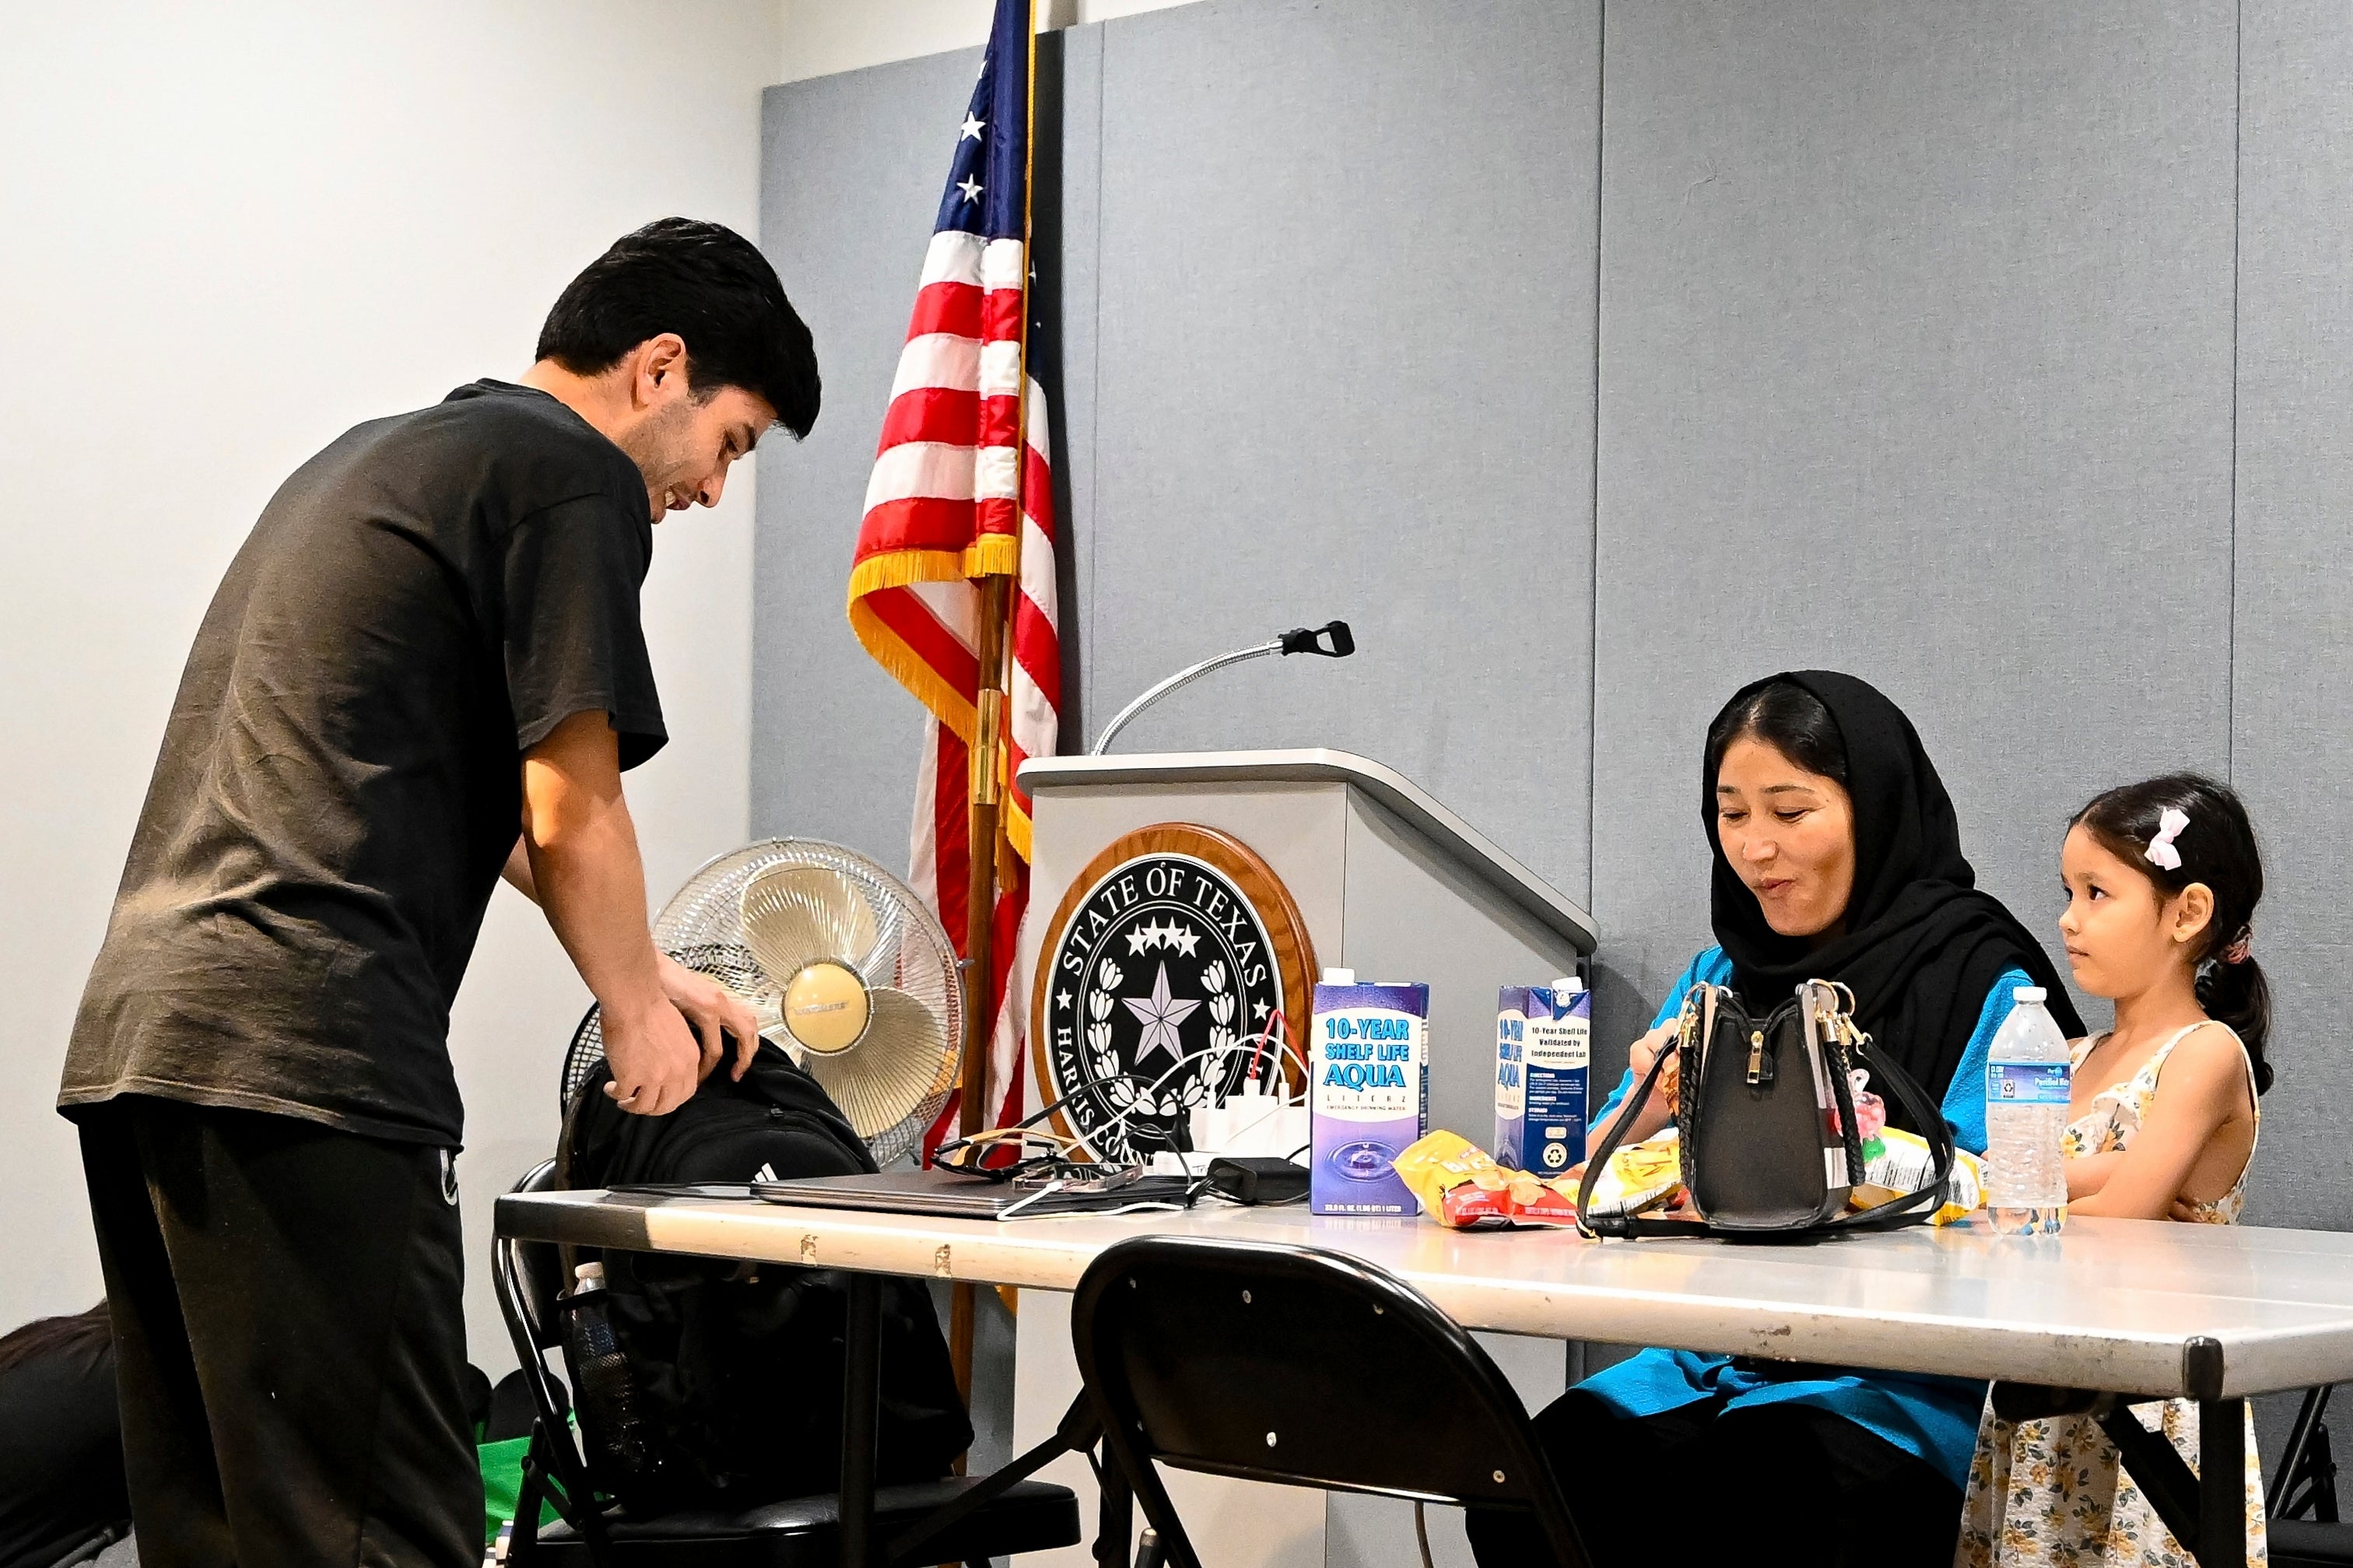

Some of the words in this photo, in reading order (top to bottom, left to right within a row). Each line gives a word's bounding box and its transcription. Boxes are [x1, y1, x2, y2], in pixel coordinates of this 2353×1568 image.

[1063, 875, 1139, 977] STATE
[1146, 867, 1185, 898] OF
[1193, 875, 1267, 988] TEXAS
[1326, 1018, 1409, 1040] 10-YEAR
[1325, 1044, 1373, 1061] SHELF
[1377, 1045, 1409, 1061] LIFE
[1323, 1064, 1406, 1092] AQUA
